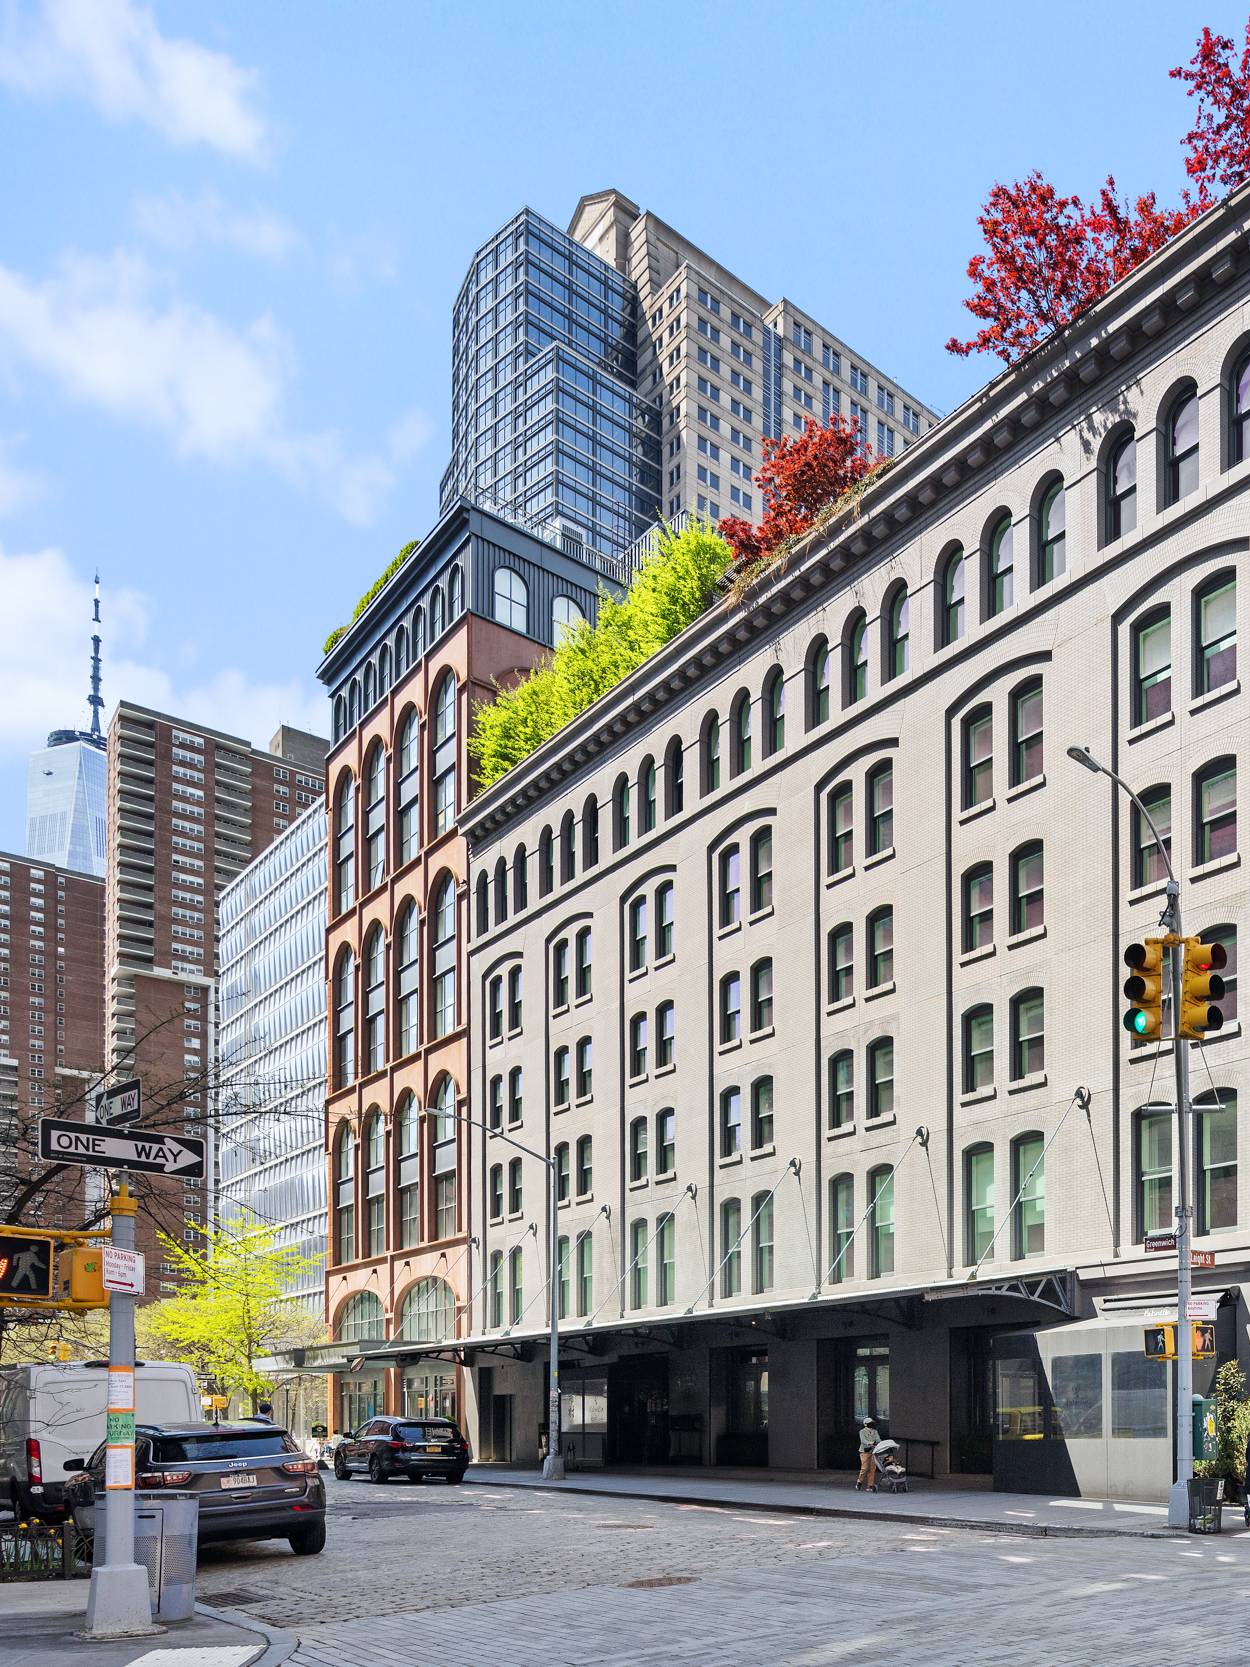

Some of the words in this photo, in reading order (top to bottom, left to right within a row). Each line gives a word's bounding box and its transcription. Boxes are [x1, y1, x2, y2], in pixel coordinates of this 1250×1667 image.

[99, 1101, 113, 1120] ONE
[120, 1093, 137, 1112] WAY
[56, 1133, 106, 1154] ONE
[134, 1143, 184, 1164] WAY
[1146, 1238, 1175, 1248] Greenwich
[106, 1250, 114, 1258] NO
[114, 1252, 136, 1263] PARKING
[1191, 1252, 1205, 1266] Laight
[1206, 1254, 1212, 1265] St
[106, 1260, 120, 1269] Monday
[124, 1264, 136, 1273] Friday
